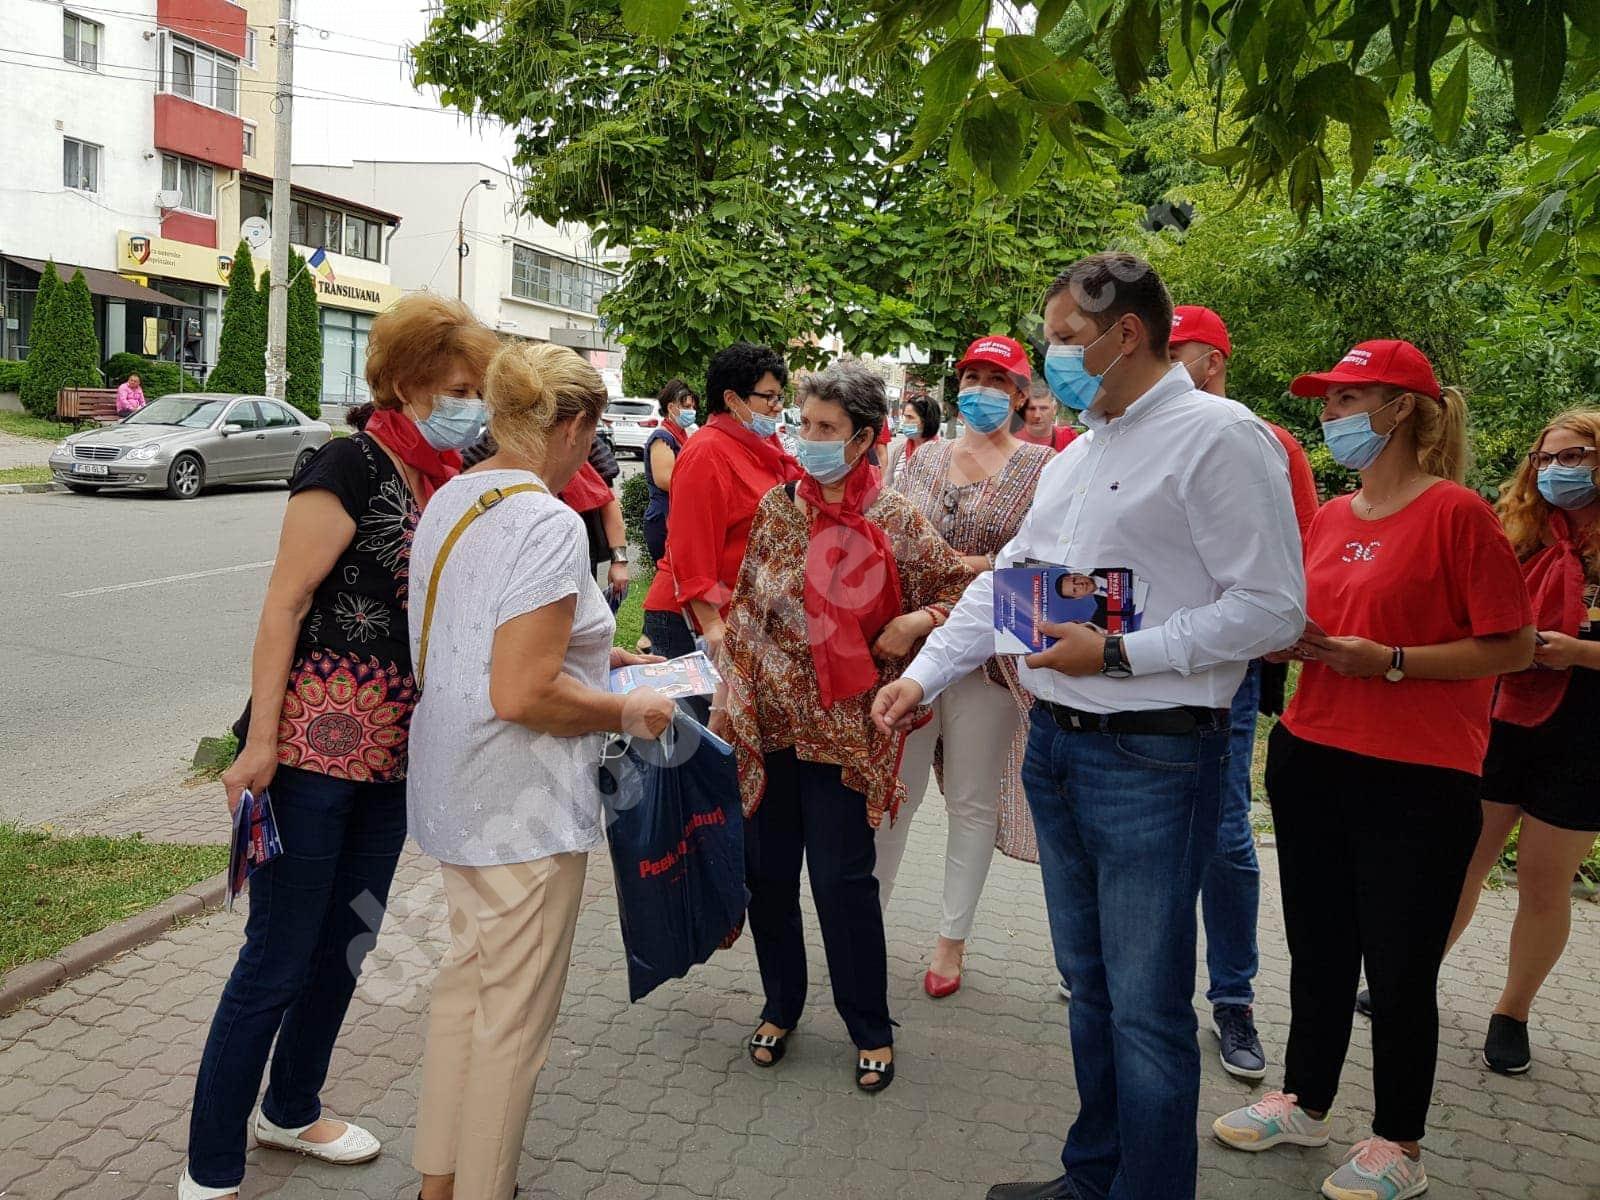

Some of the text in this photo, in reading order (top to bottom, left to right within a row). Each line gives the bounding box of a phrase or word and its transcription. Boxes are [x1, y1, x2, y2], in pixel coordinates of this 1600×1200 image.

[133, 242, 145, 253] BT
[220, 261, 229, 271] BT
[318, 280, 381, 304] TRANSILVANIA
